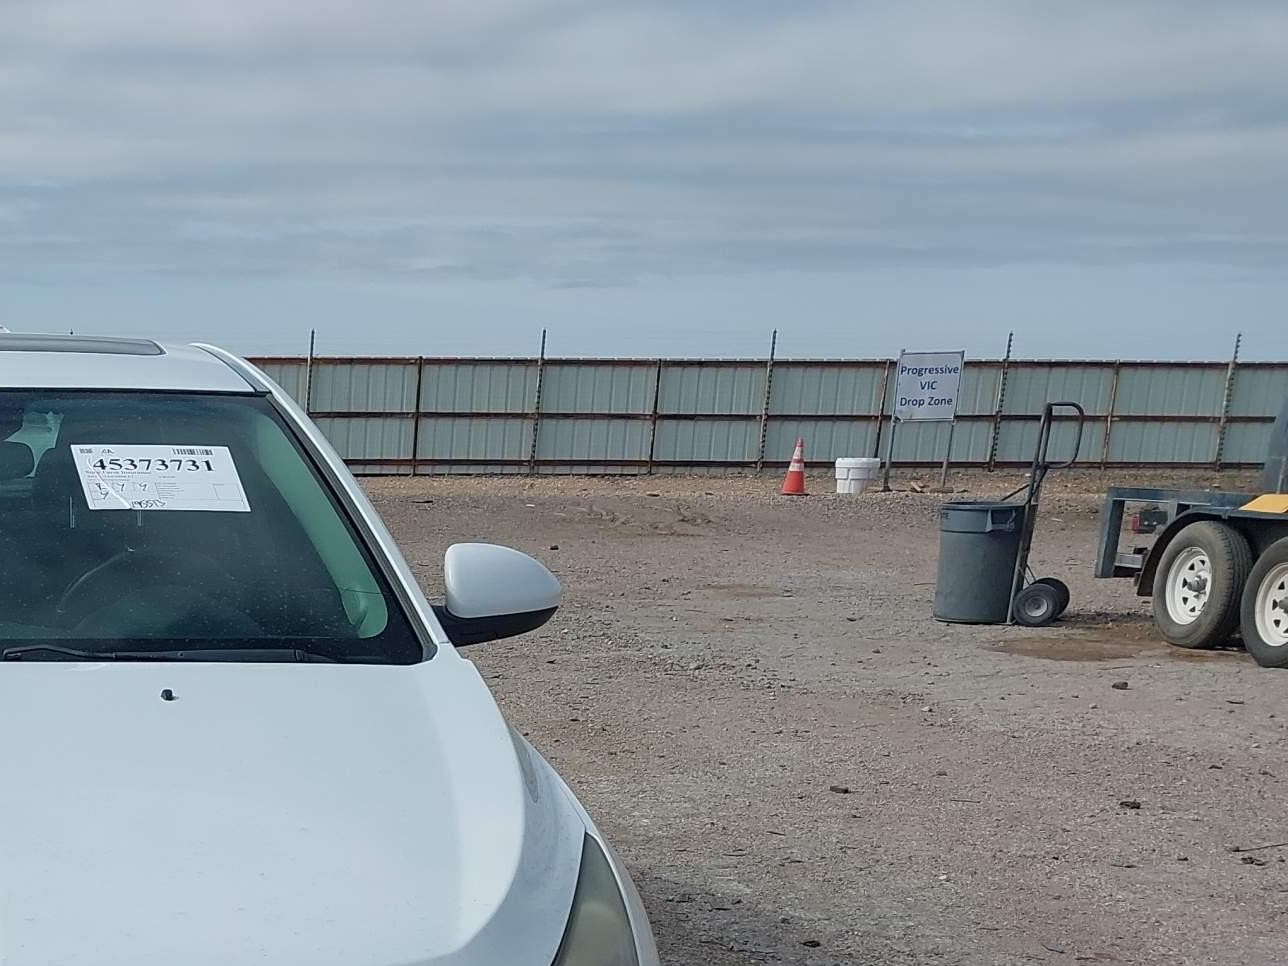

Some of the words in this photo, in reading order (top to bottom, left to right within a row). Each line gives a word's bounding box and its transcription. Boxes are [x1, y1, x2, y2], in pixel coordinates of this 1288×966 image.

[900, 365, 959, 376] Progressive
[920, 381, 938, 390] VIC
[900, 397, 925, 408] Drop
[927, 396, 953, 406] Zone
[93, 458, 215, 472] 45373731
